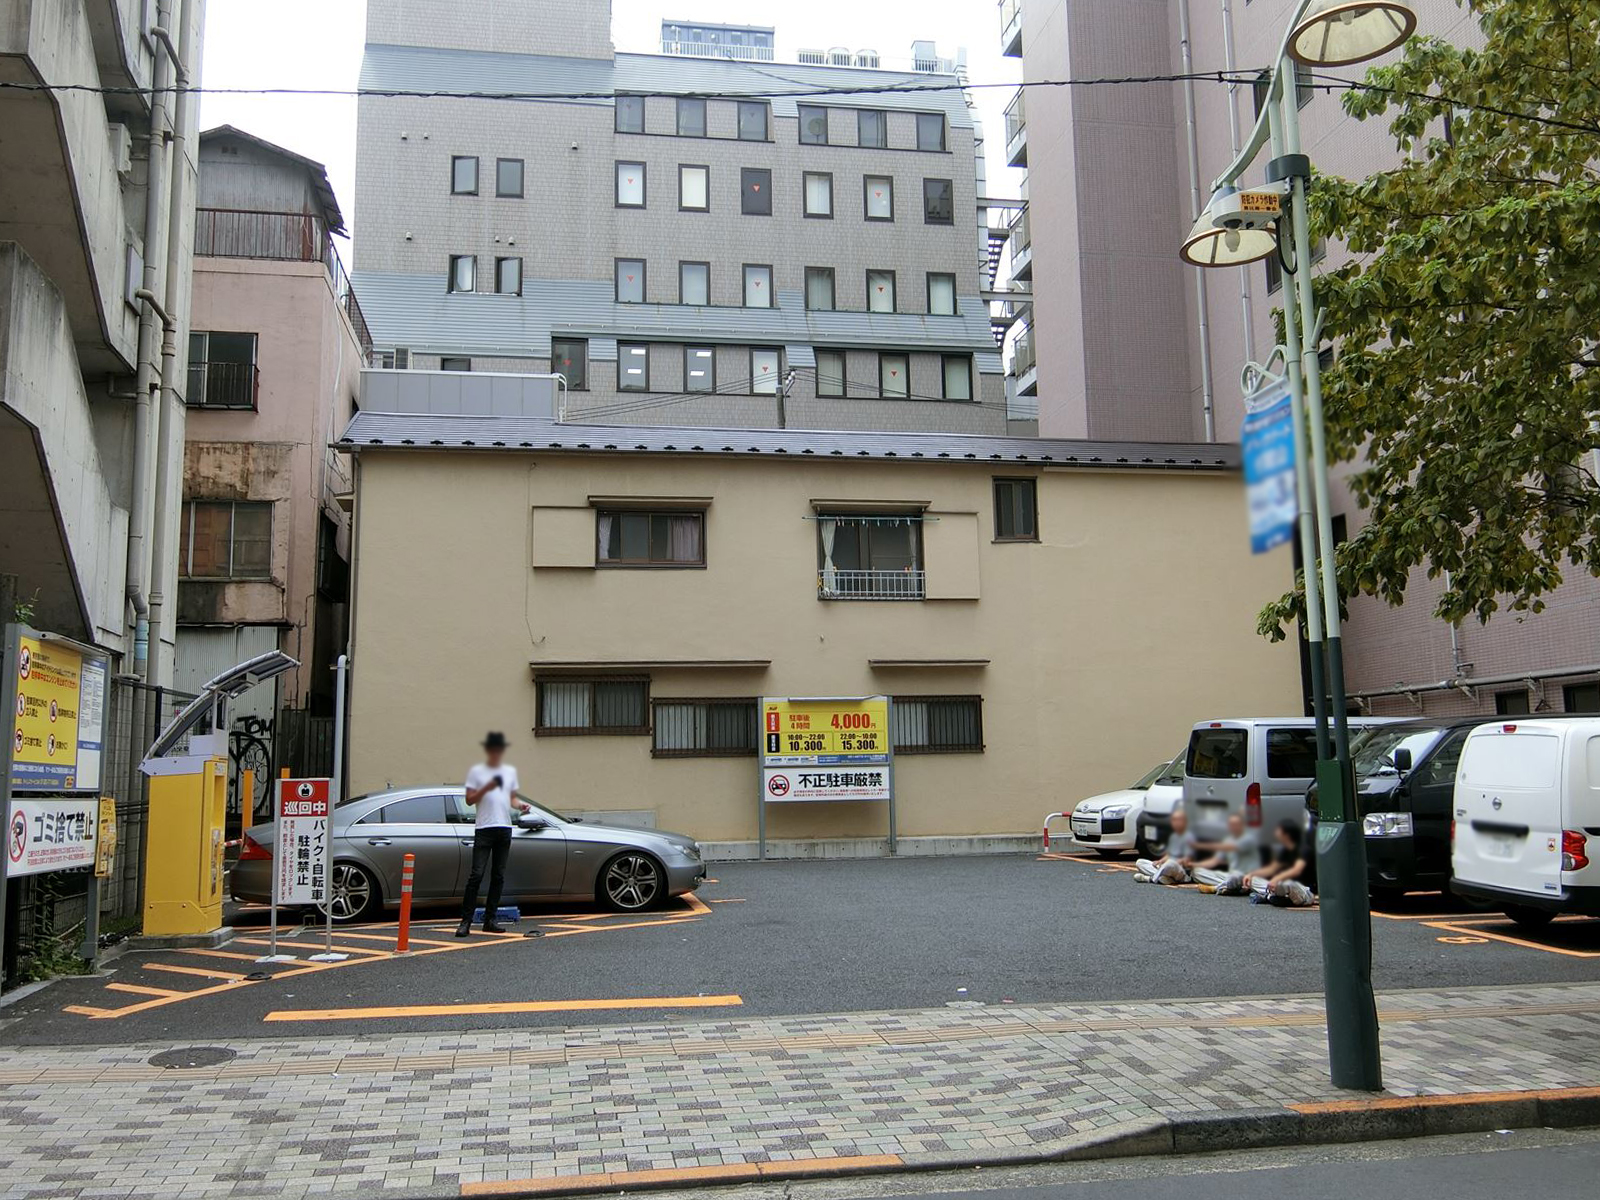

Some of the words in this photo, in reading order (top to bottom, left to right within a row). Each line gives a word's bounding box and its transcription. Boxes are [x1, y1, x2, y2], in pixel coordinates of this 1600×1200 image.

[831, 713, 876, 729] 4,000円
[798, 771, 883, 788] 不正駐車厳禁
[284, 800, 326, 815] 巡回中
[33, 811, 94, 844] ゴミ捨て禁止
[296, 835, 311, 886] 駐輪禁止
[311, 819, 326, 901] バイク・自転車
